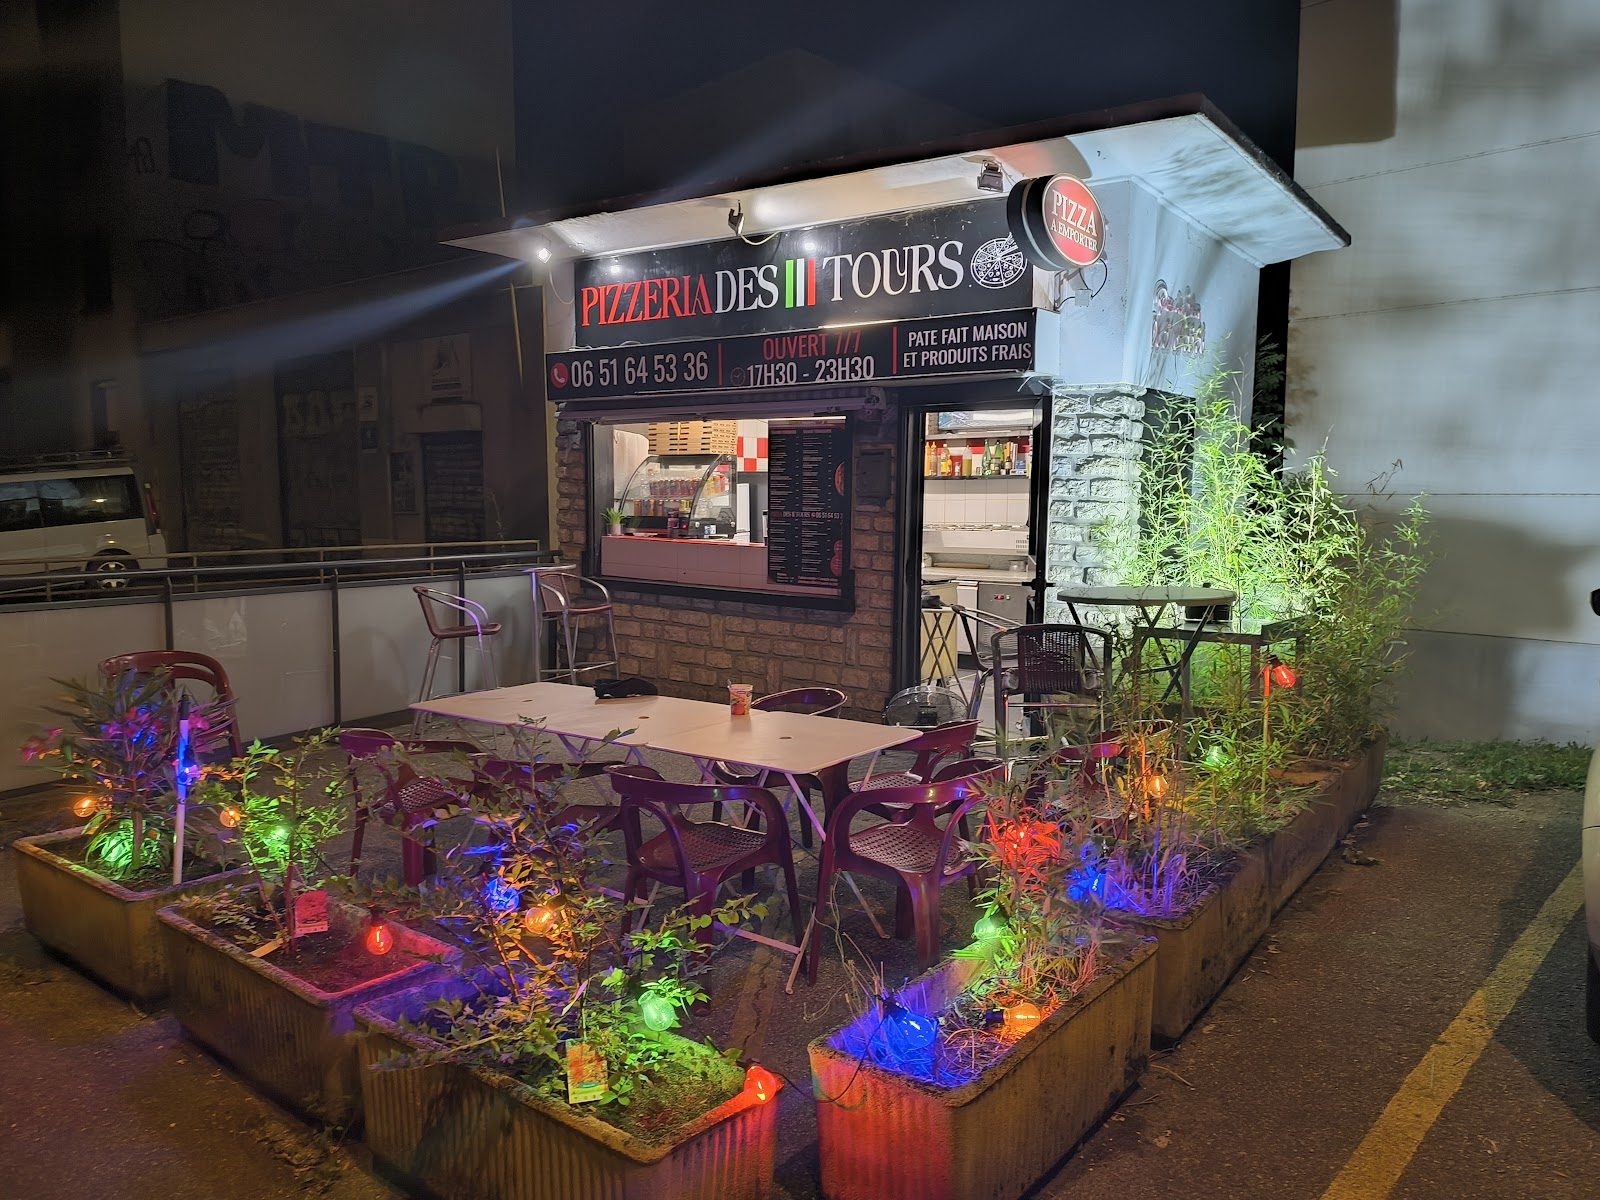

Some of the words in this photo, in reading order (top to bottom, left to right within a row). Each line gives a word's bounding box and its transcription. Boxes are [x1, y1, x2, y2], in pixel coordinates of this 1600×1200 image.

[1052, 189, 1097, 237] PIZZA
[1058, 221, 1098, 252] EMPORTER
[581, 274, 712, 327] PIZZERIA
[715, 264, 779, 314] DES
[822, 240, 964, 302] TOURS
[763, 333, 829, 361] OUVERT
[908, 330, 939, 347] PATE
[941, 326, 969, 345] FAIT
[972, 321, 1028, 342] MAISON
[571, 360, 594, 388] 06
[600, 358, 618, 386] 51
[624, 356, 648, 385] 64
[654, 353, 677, 383] 53
[683, 351, 709, 381] 36
[903, 351, 918, 368] ET
[921, 346, 988, 367] PRODUITS
[991, 342, 1032, 361] FRAIS
[747, 362, 797, 387] 17H30
[815, 355, 875, 383] 23H30
